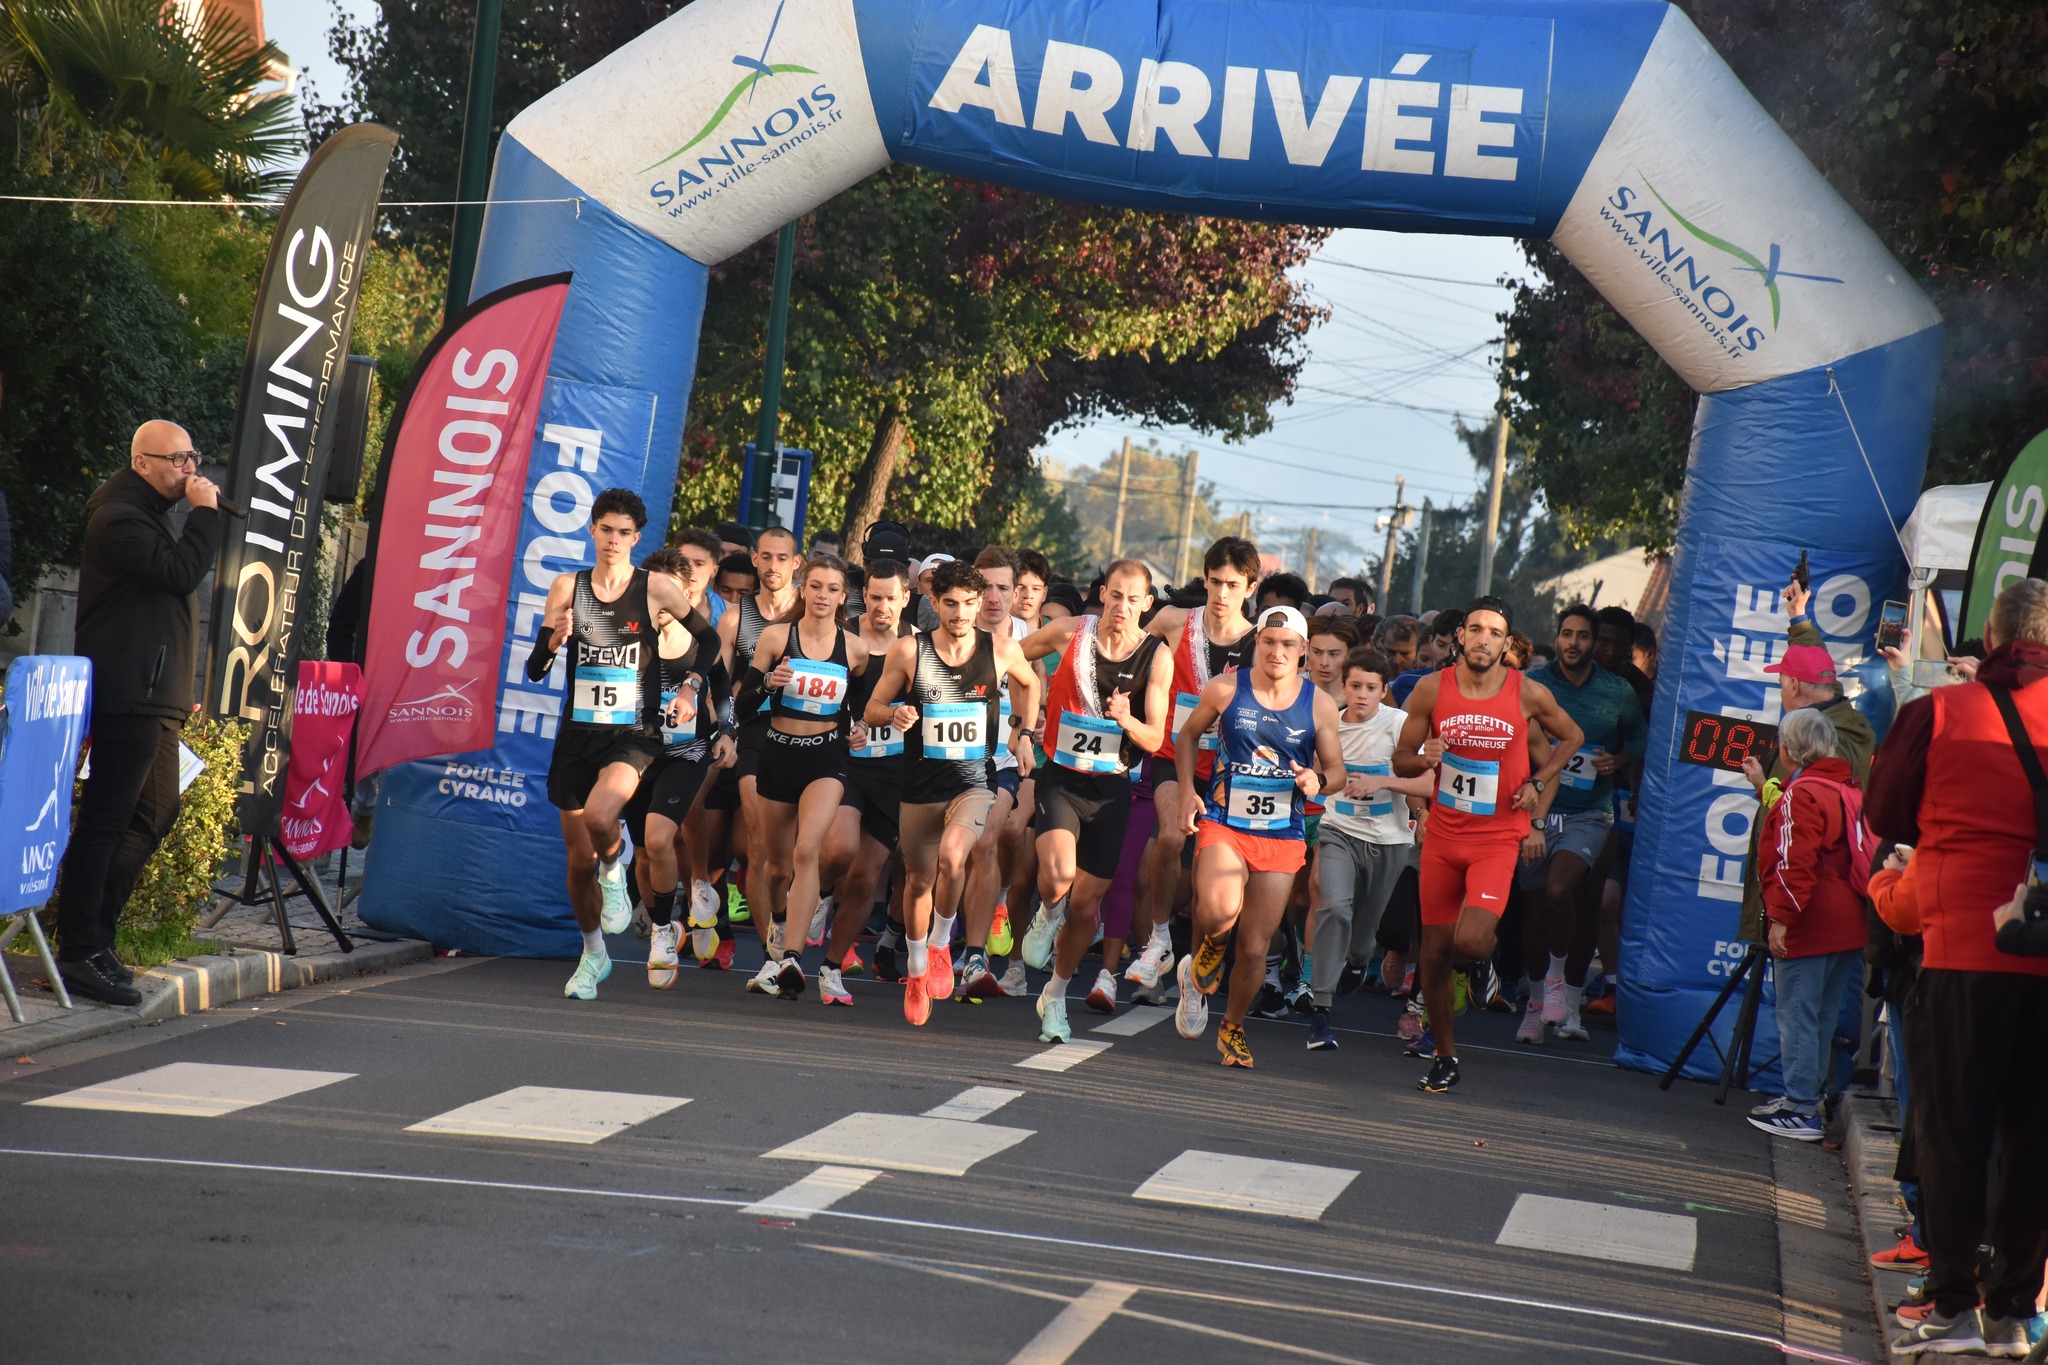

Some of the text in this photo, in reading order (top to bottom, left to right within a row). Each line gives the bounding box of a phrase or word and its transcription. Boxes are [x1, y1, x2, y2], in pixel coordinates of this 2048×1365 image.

[927, 23, 1524, 182] ARRIVÉE
[650, 84, 836, 207] SANNOIS
[668, 107, 843, 218] www.ville-sannois.fr
[1608, 186, 1766, 352] SANNOIS
[1600, 206, 1743, 360] www.ville-sannois.fr
[219, 225, 334, 722] ROTIMING
[262, 549, 303, 797] ACCELERATEUR
[290, 496, 307, 539] DE
[301, 241, 357, 486] PERFORMANCE
[405, 347, 519, 669] SANNOIS
[25, 664, 45, 722] Ville
[43, 664, 57, 719] de
[591, 685, 618, 707] 15
[796, 676, 838, 700] 184
[388, 706, 473, 719] SANNOIS
[389, 714, 471, 724] www.ville-sannois.fr
[1440, 714, 1515, 736] PIERREFITTE
[789, 736, 824, 747] PRO
[933, 721, 978, 743] 106
[1072, 732, 1102, 756] 24
[1445, 737, 1507, 750] VILLETANEUSE
[444, 761, 526, 788] FOULÉE
[1452, 774, 1476, 797] 41
[438, 778, 527, 808] CYRANO
[1246, 794, 1276, 816] 35
